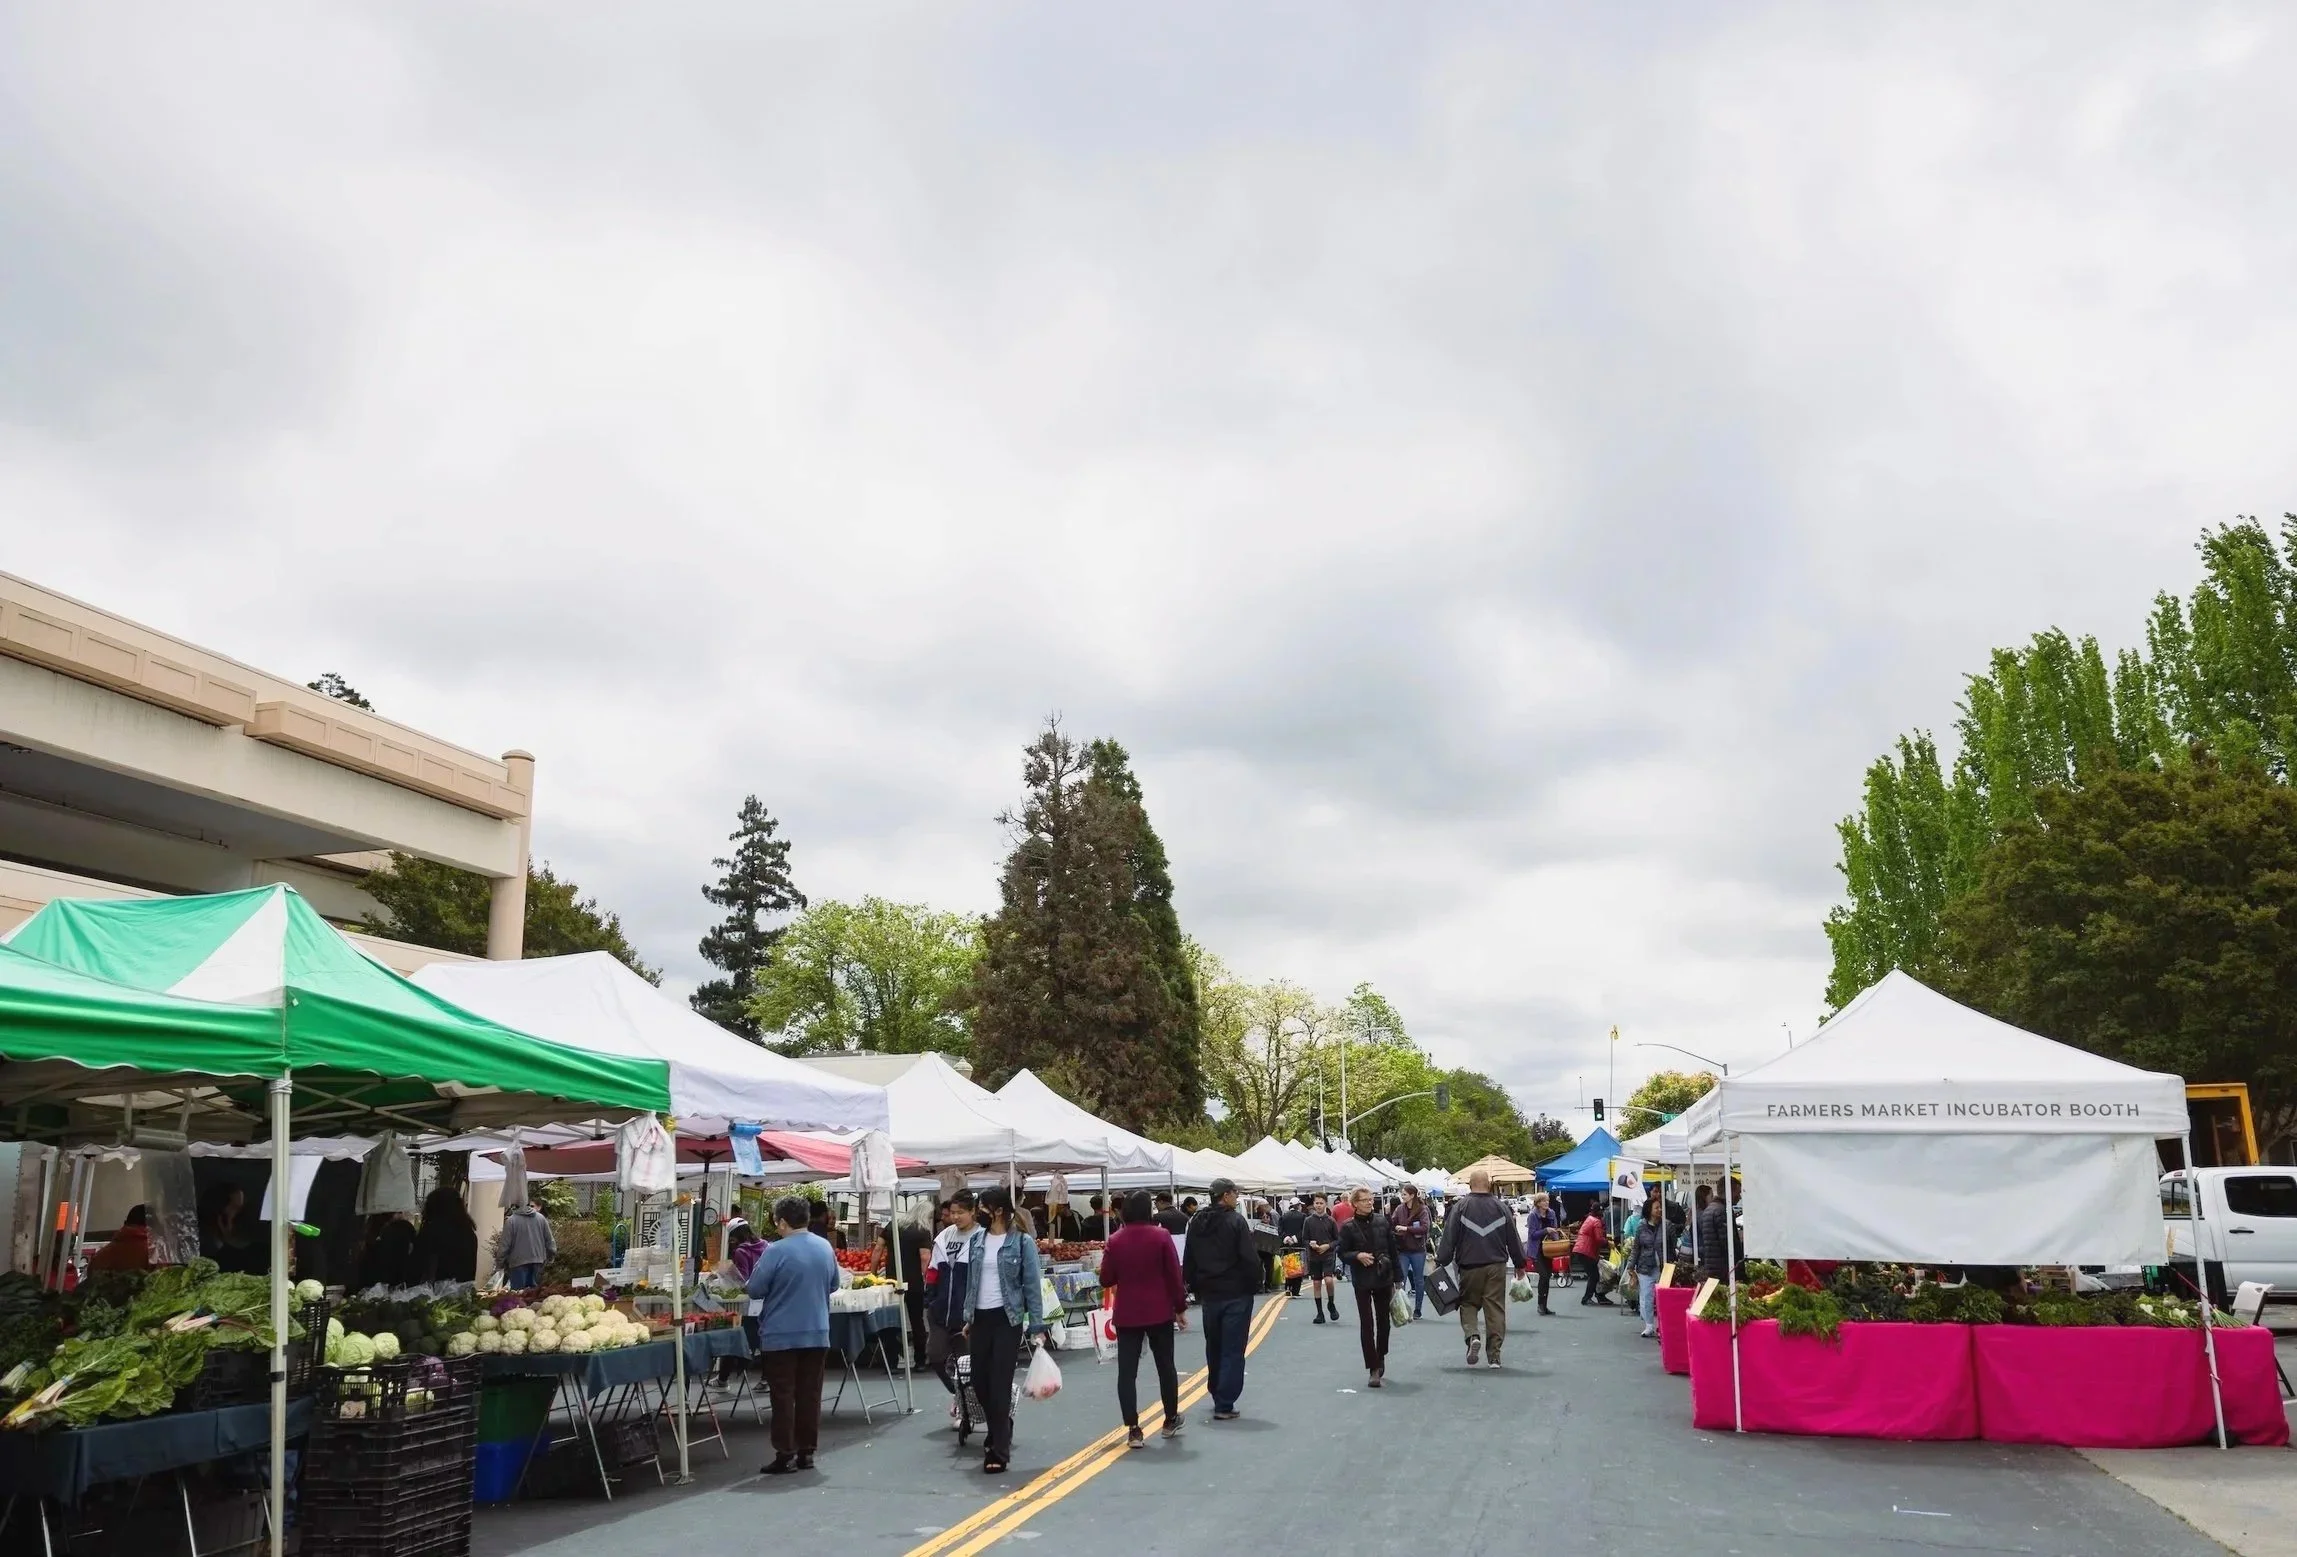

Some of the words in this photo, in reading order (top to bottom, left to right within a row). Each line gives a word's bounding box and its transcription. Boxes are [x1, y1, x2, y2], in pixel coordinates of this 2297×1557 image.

[1767, 1104, 1854, 1117] FARMERS
[1861, 1103, 1939, 1116] MARKET
[1947, 1103, 2062, 1116] INCUBATOR
[2070, 1103, 2140, 1116] BOOTH
[946, 1241, 964, 1250] JUST
